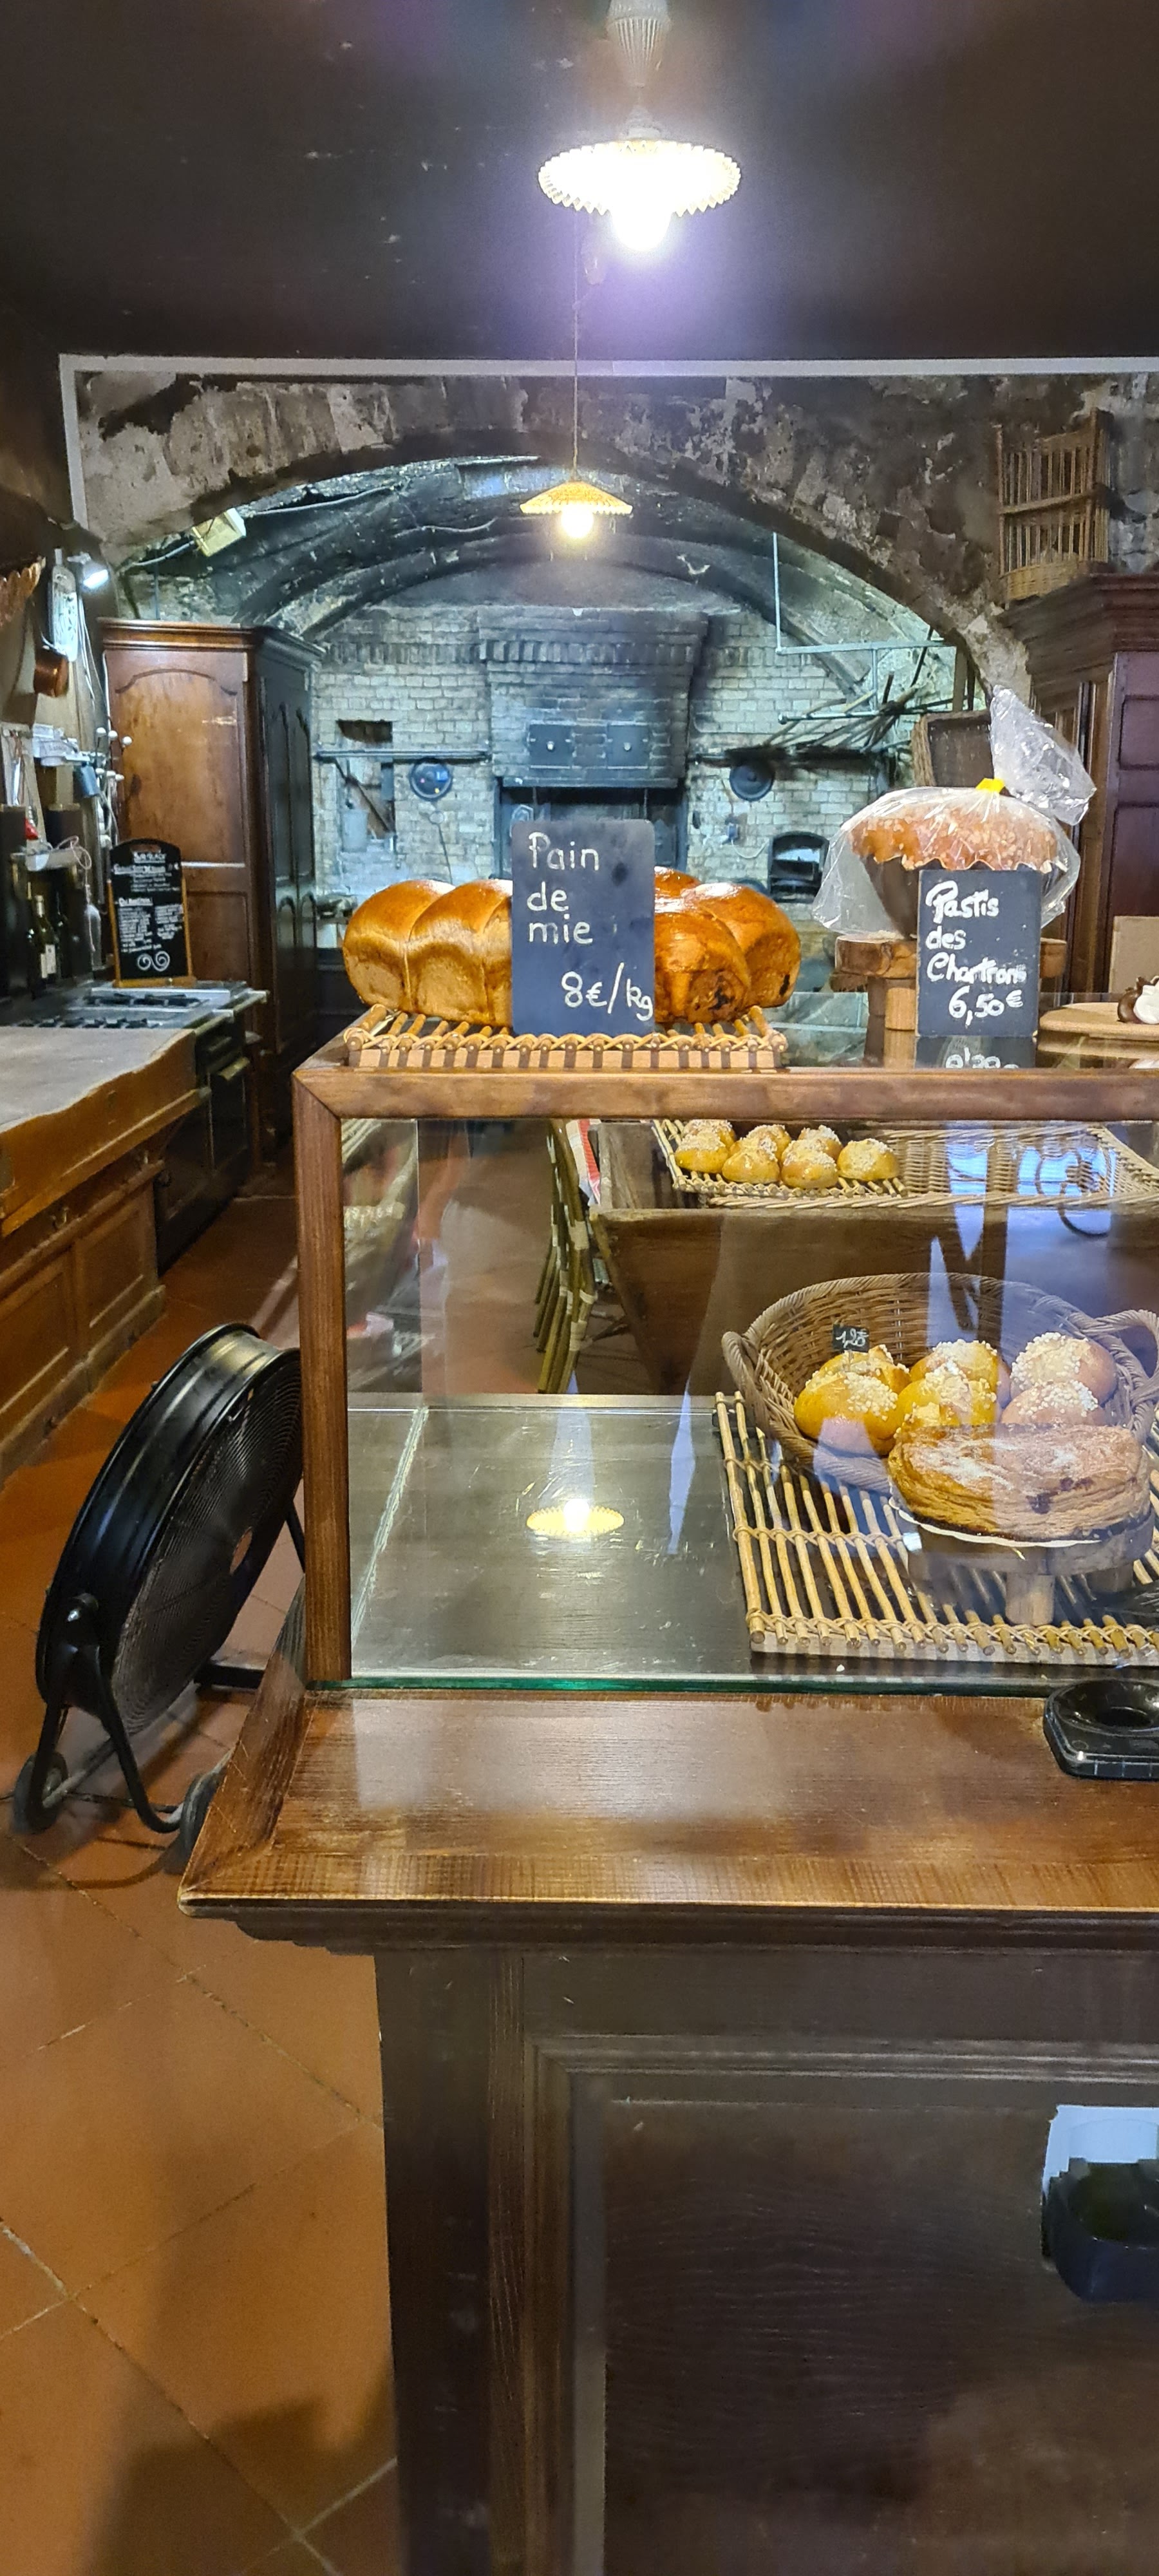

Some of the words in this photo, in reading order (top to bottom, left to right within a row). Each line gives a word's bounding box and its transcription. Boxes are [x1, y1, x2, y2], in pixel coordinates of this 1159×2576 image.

[529, 831, 599, 871] Pain
[527, 881, 569, 912] de
[925, 880, 999, 923] Pastis
[529, 913, 593, 944] mie
[925, 925, 966, 950] des
[948, 985, 1024, 1028] 6,50€
